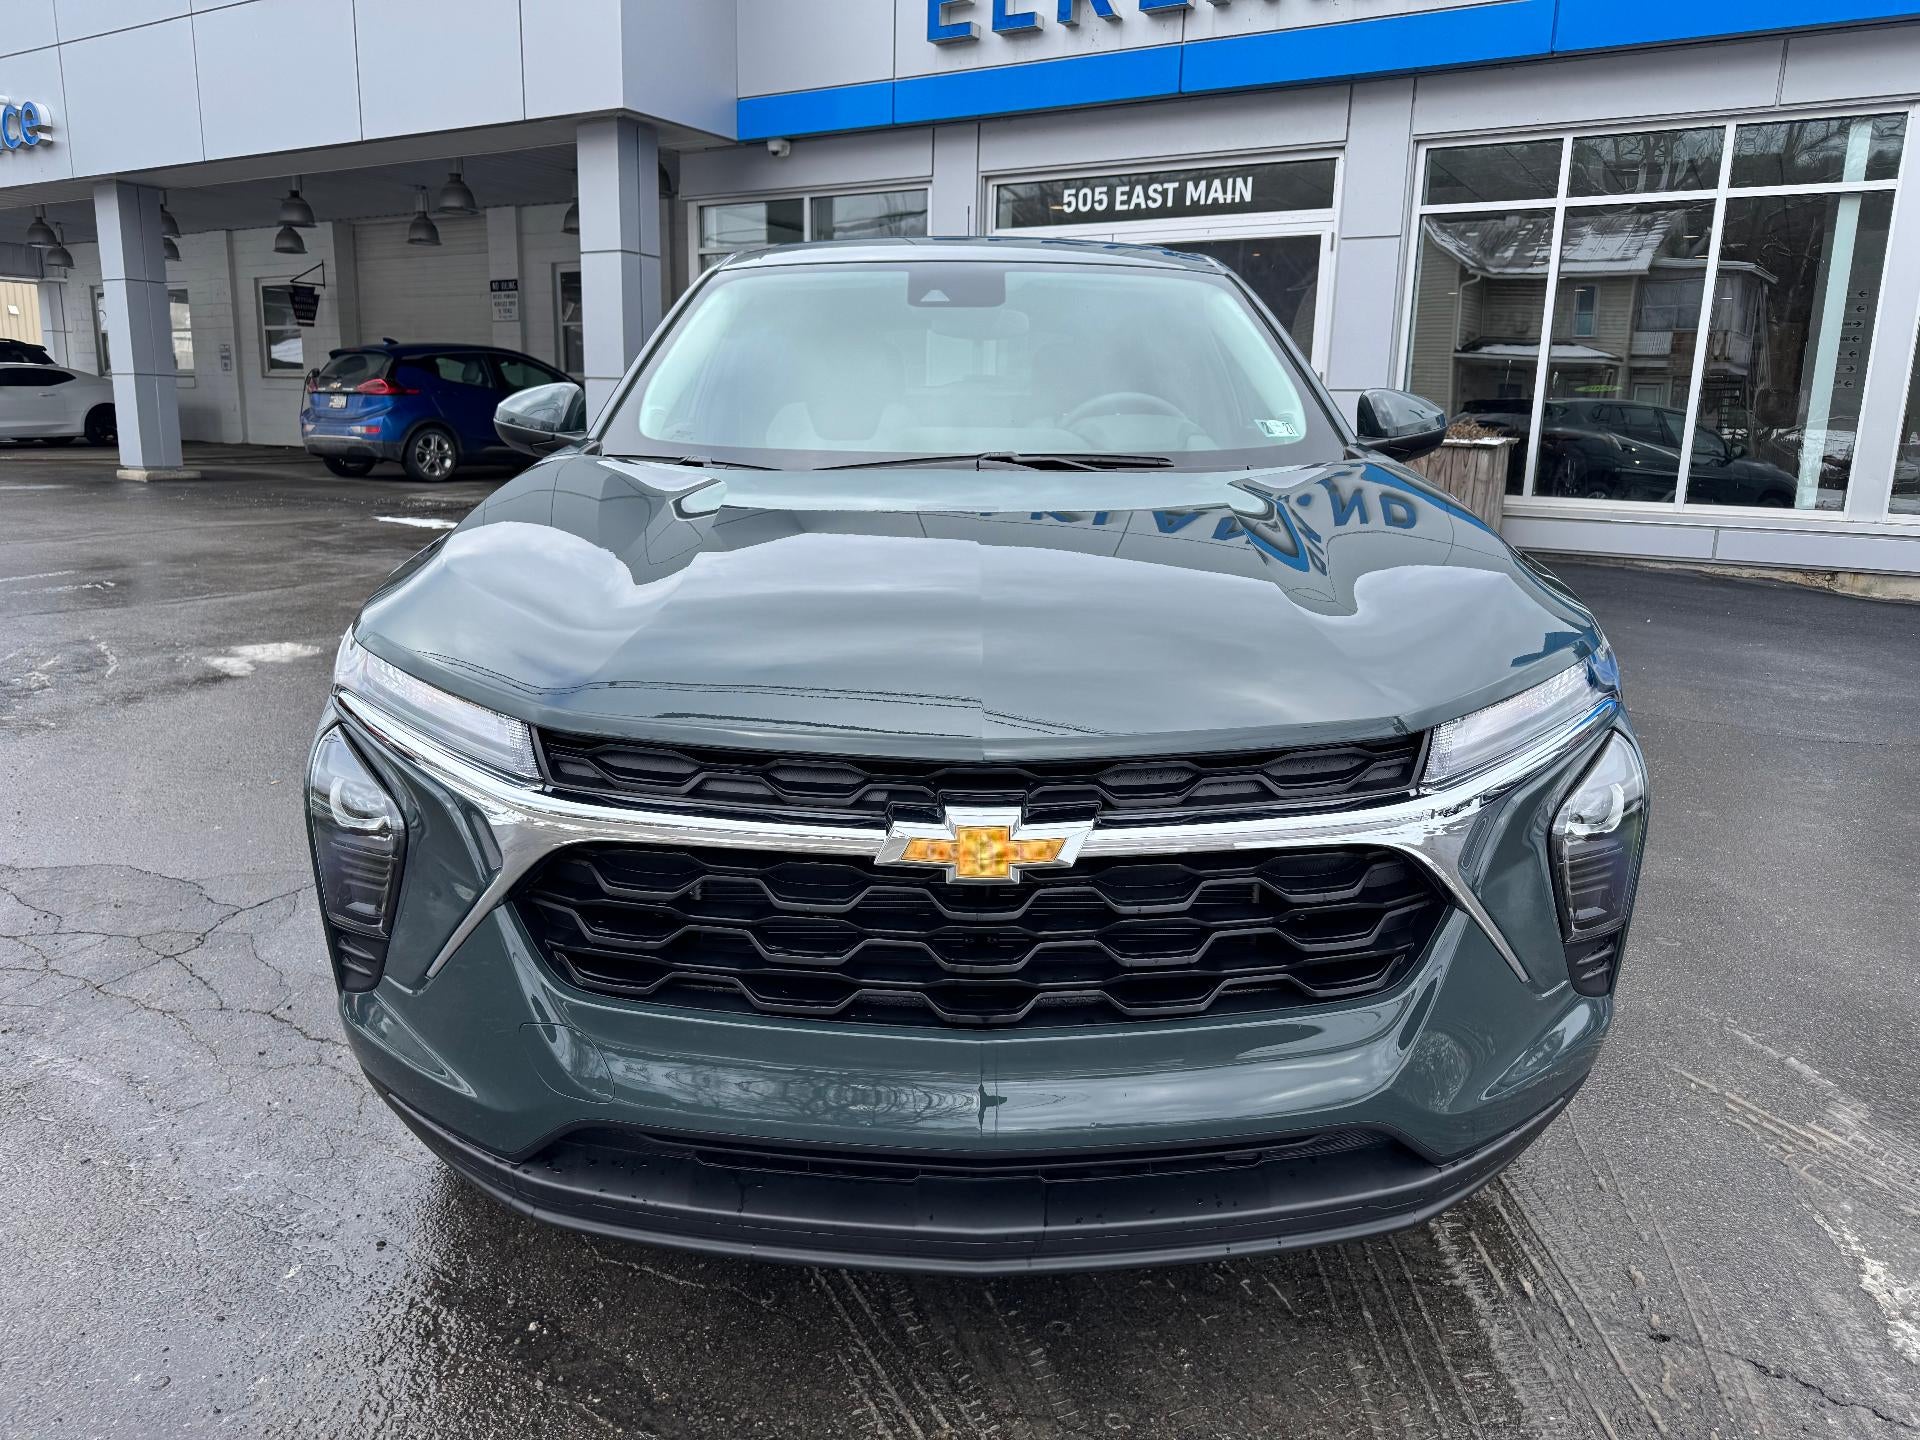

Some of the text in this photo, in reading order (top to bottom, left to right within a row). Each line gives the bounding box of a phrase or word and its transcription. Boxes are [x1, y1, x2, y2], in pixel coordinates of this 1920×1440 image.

[0, 95, 52, 150] ce
[1062, 176, 1254, 214] 505 EAST MAIN
